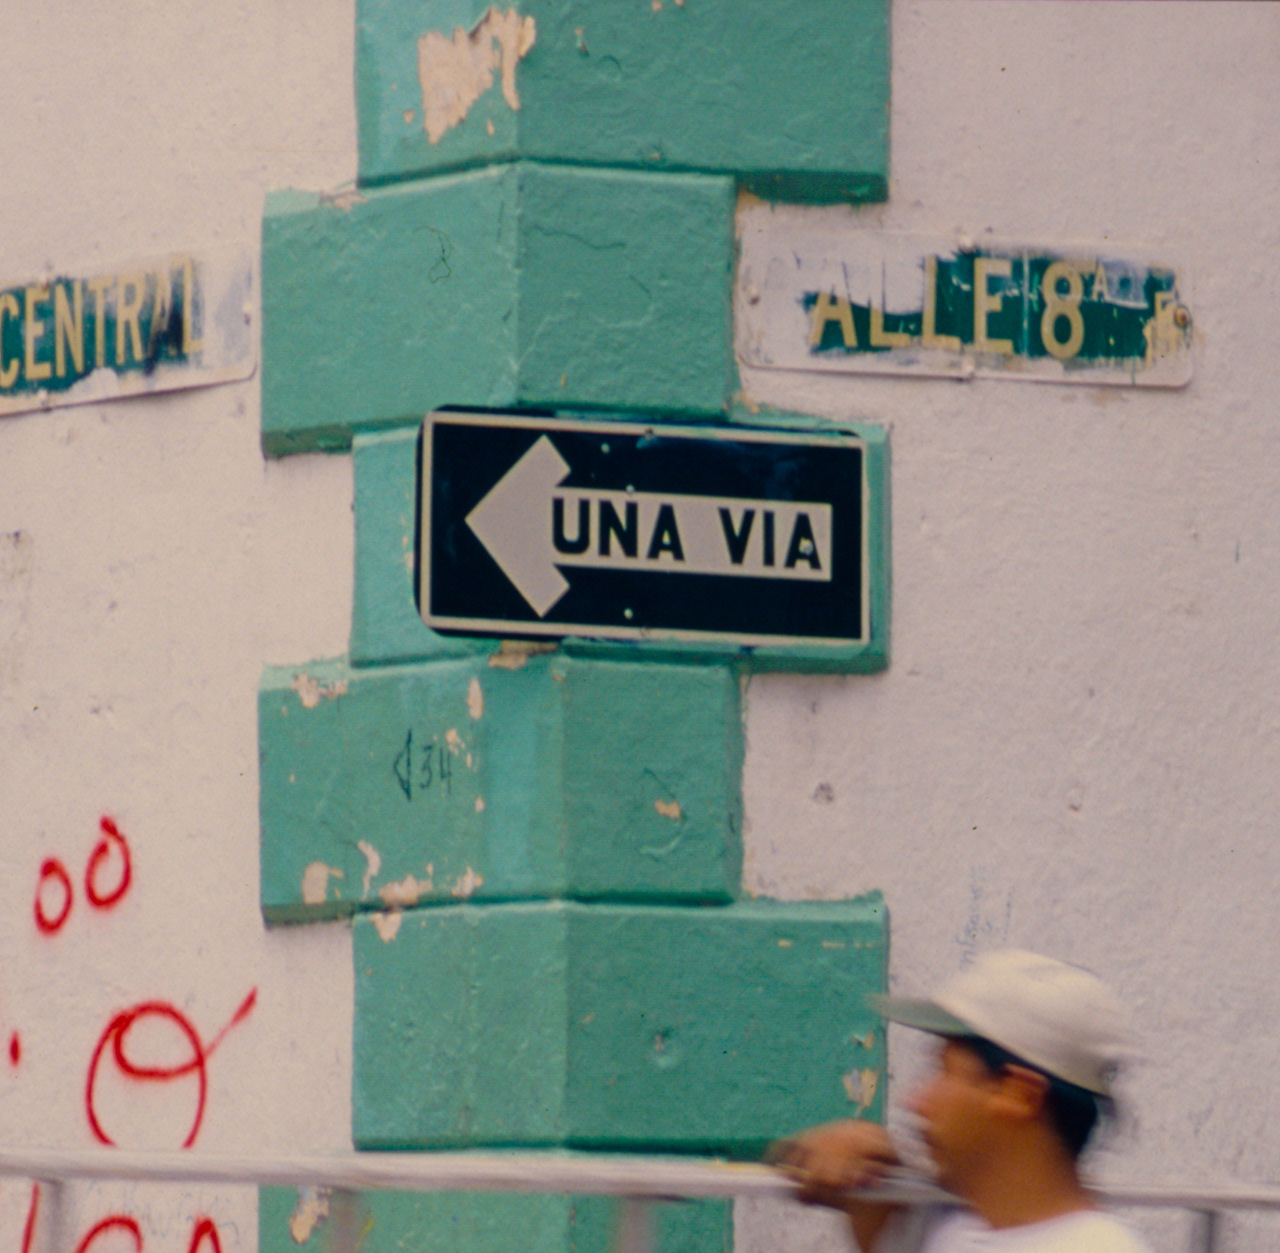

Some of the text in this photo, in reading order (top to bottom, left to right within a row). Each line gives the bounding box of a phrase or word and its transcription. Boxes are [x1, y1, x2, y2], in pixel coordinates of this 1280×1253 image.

[810, 253, 1014, 356] ALLE
[551, 496, 823, 572] UNA VIA
